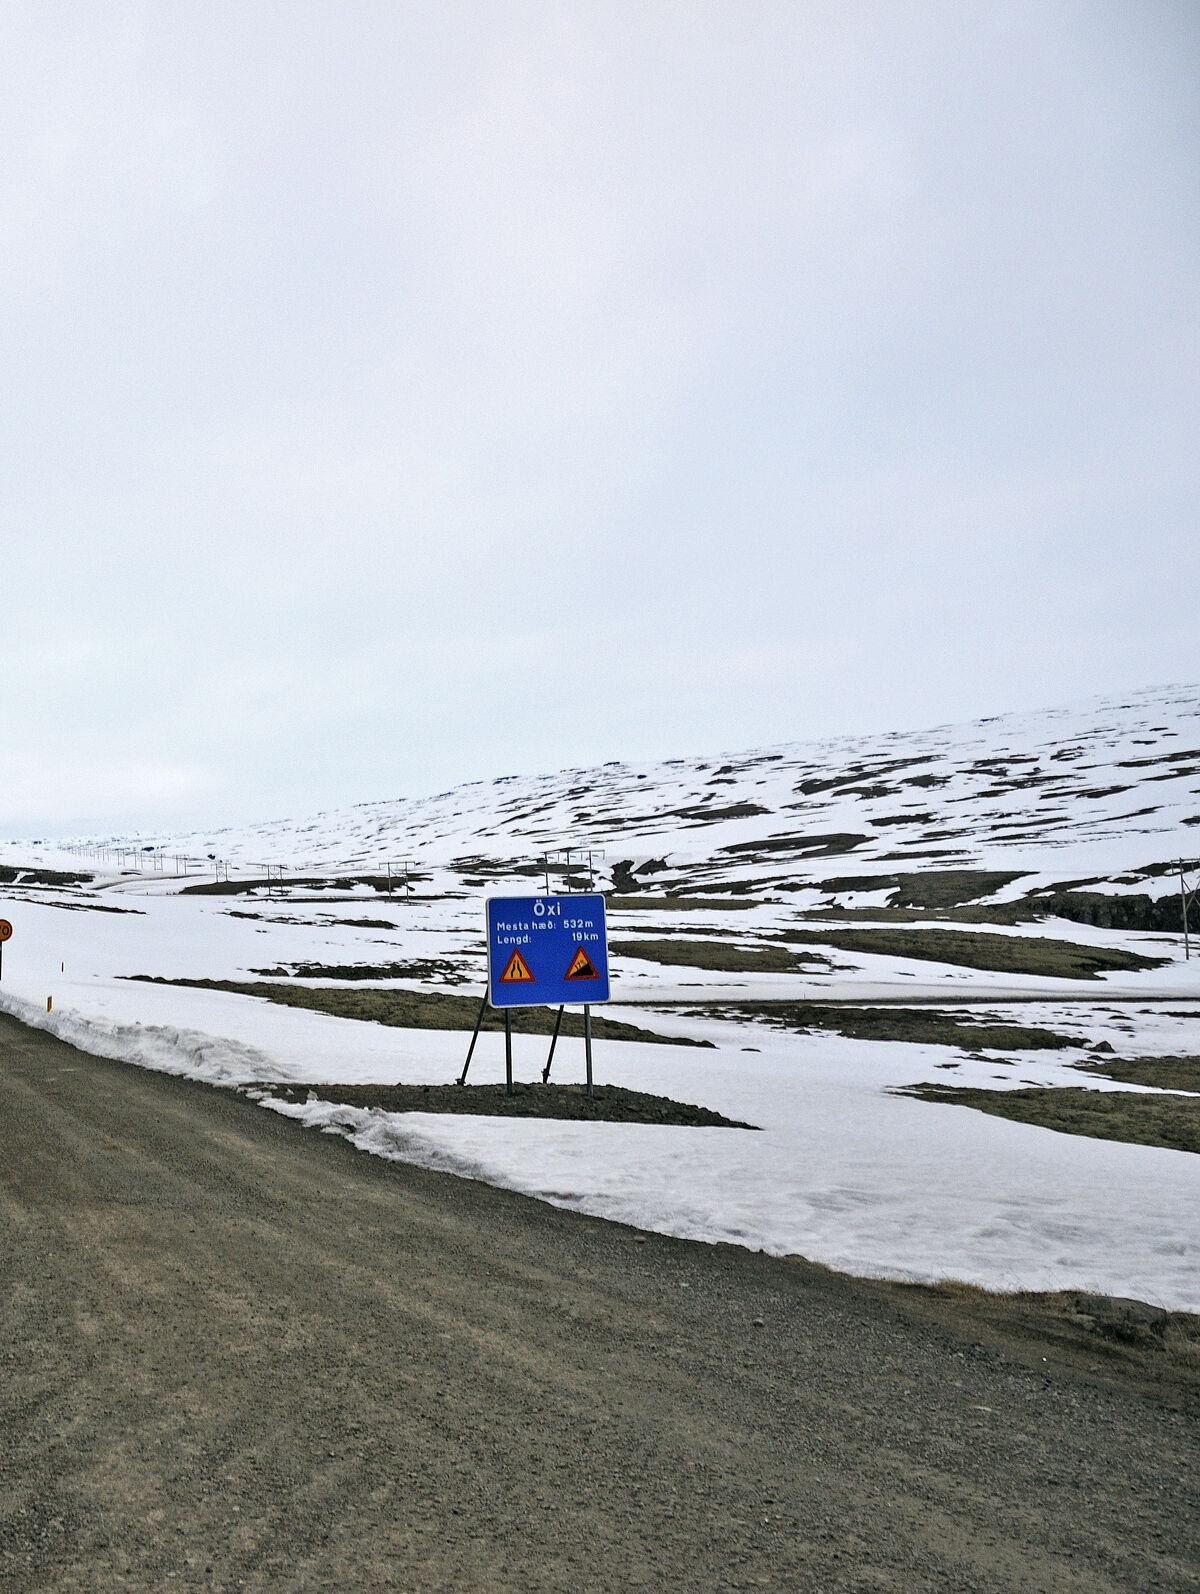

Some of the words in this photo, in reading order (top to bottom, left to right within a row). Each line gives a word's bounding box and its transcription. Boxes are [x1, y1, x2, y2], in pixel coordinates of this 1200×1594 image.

[533, 899, 561, 916] Öxi
[497, 922, 529, 931] Mesta
[532, 920, 557, 930] hæð:
[497, 935, 531, 945] Lengd:
